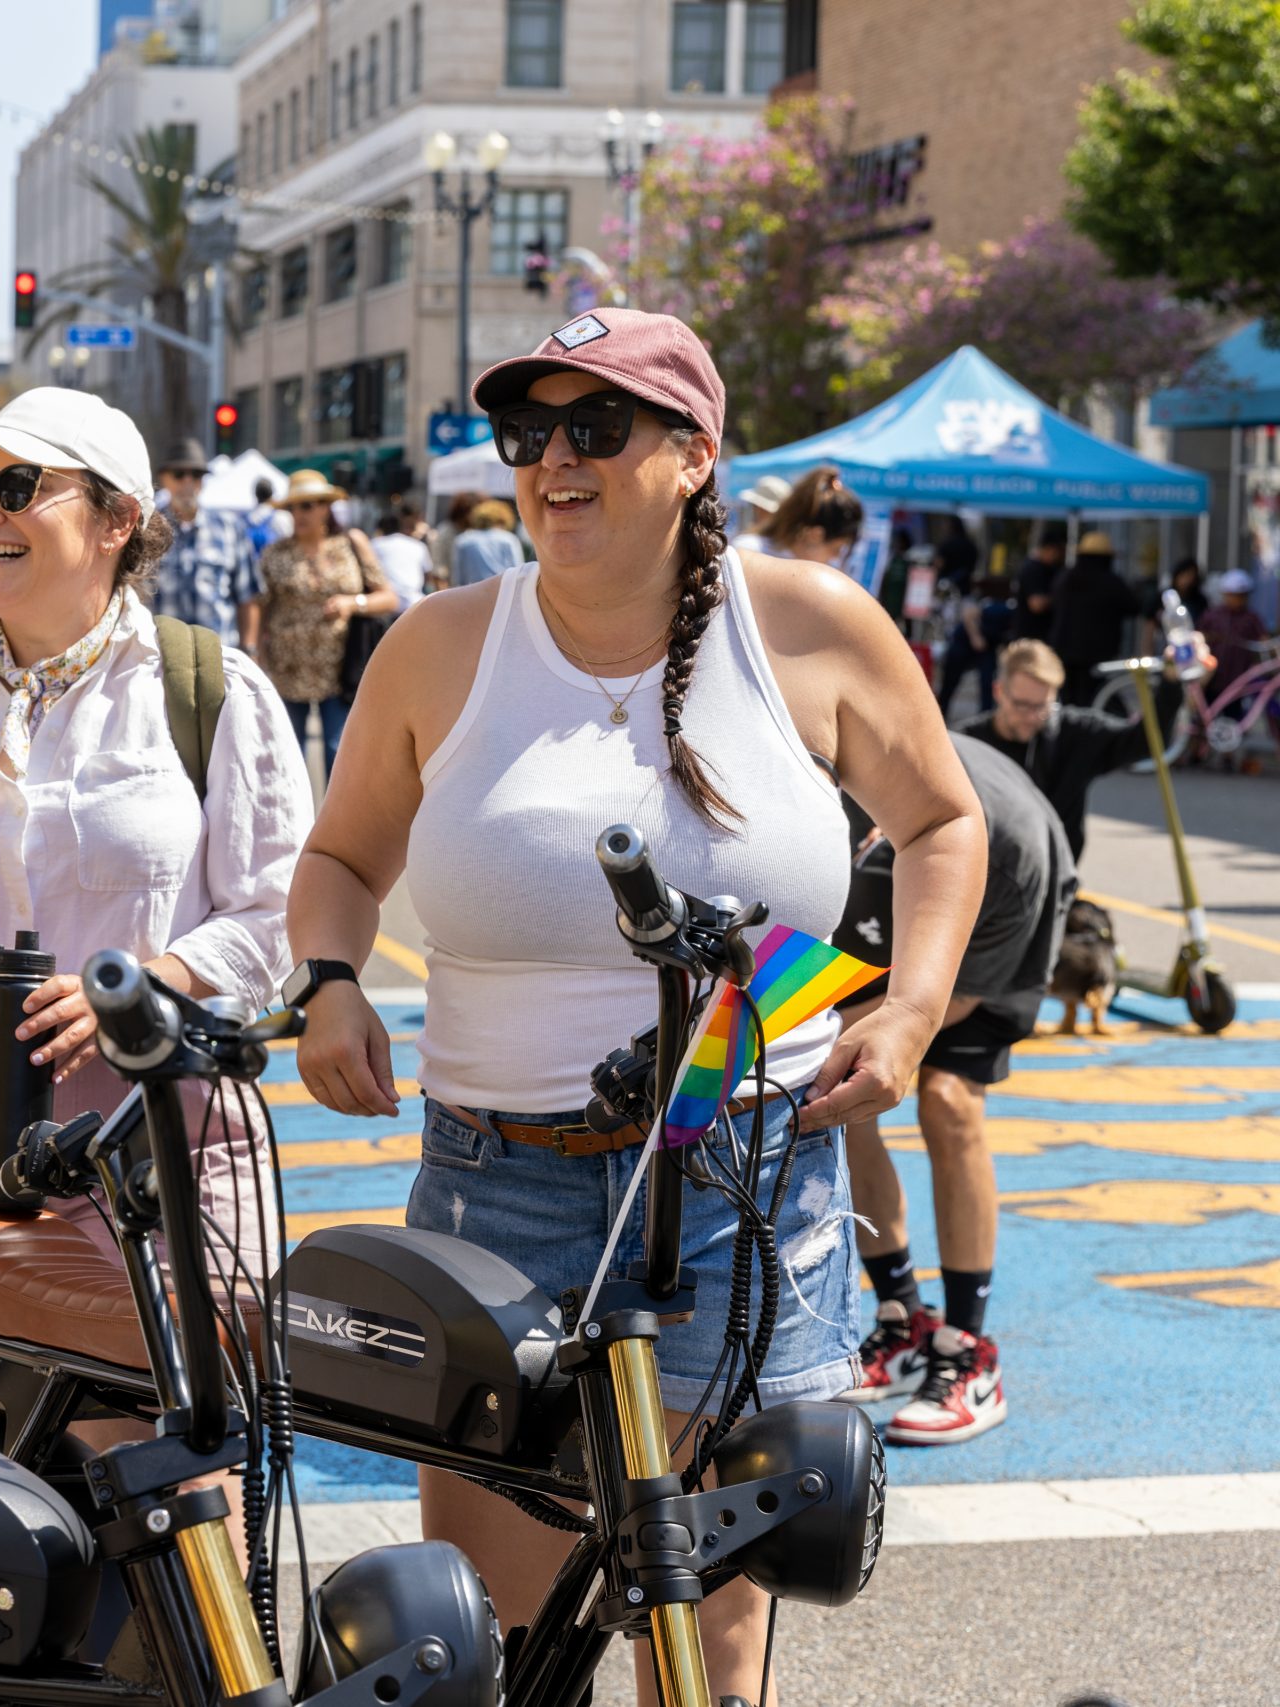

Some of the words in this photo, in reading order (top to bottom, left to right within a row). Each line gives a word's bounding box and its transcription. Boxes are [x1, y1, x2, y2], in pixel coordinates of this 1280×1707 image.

[914, 474, 967, 491] LONG
[973, 475, 1036, 494] BEACH
[1054, 480, 1124, 499] PUBLIC
[1129, 483, 1199, 503] WORKS
[307, 1308, 390, 1349] AKEZ
